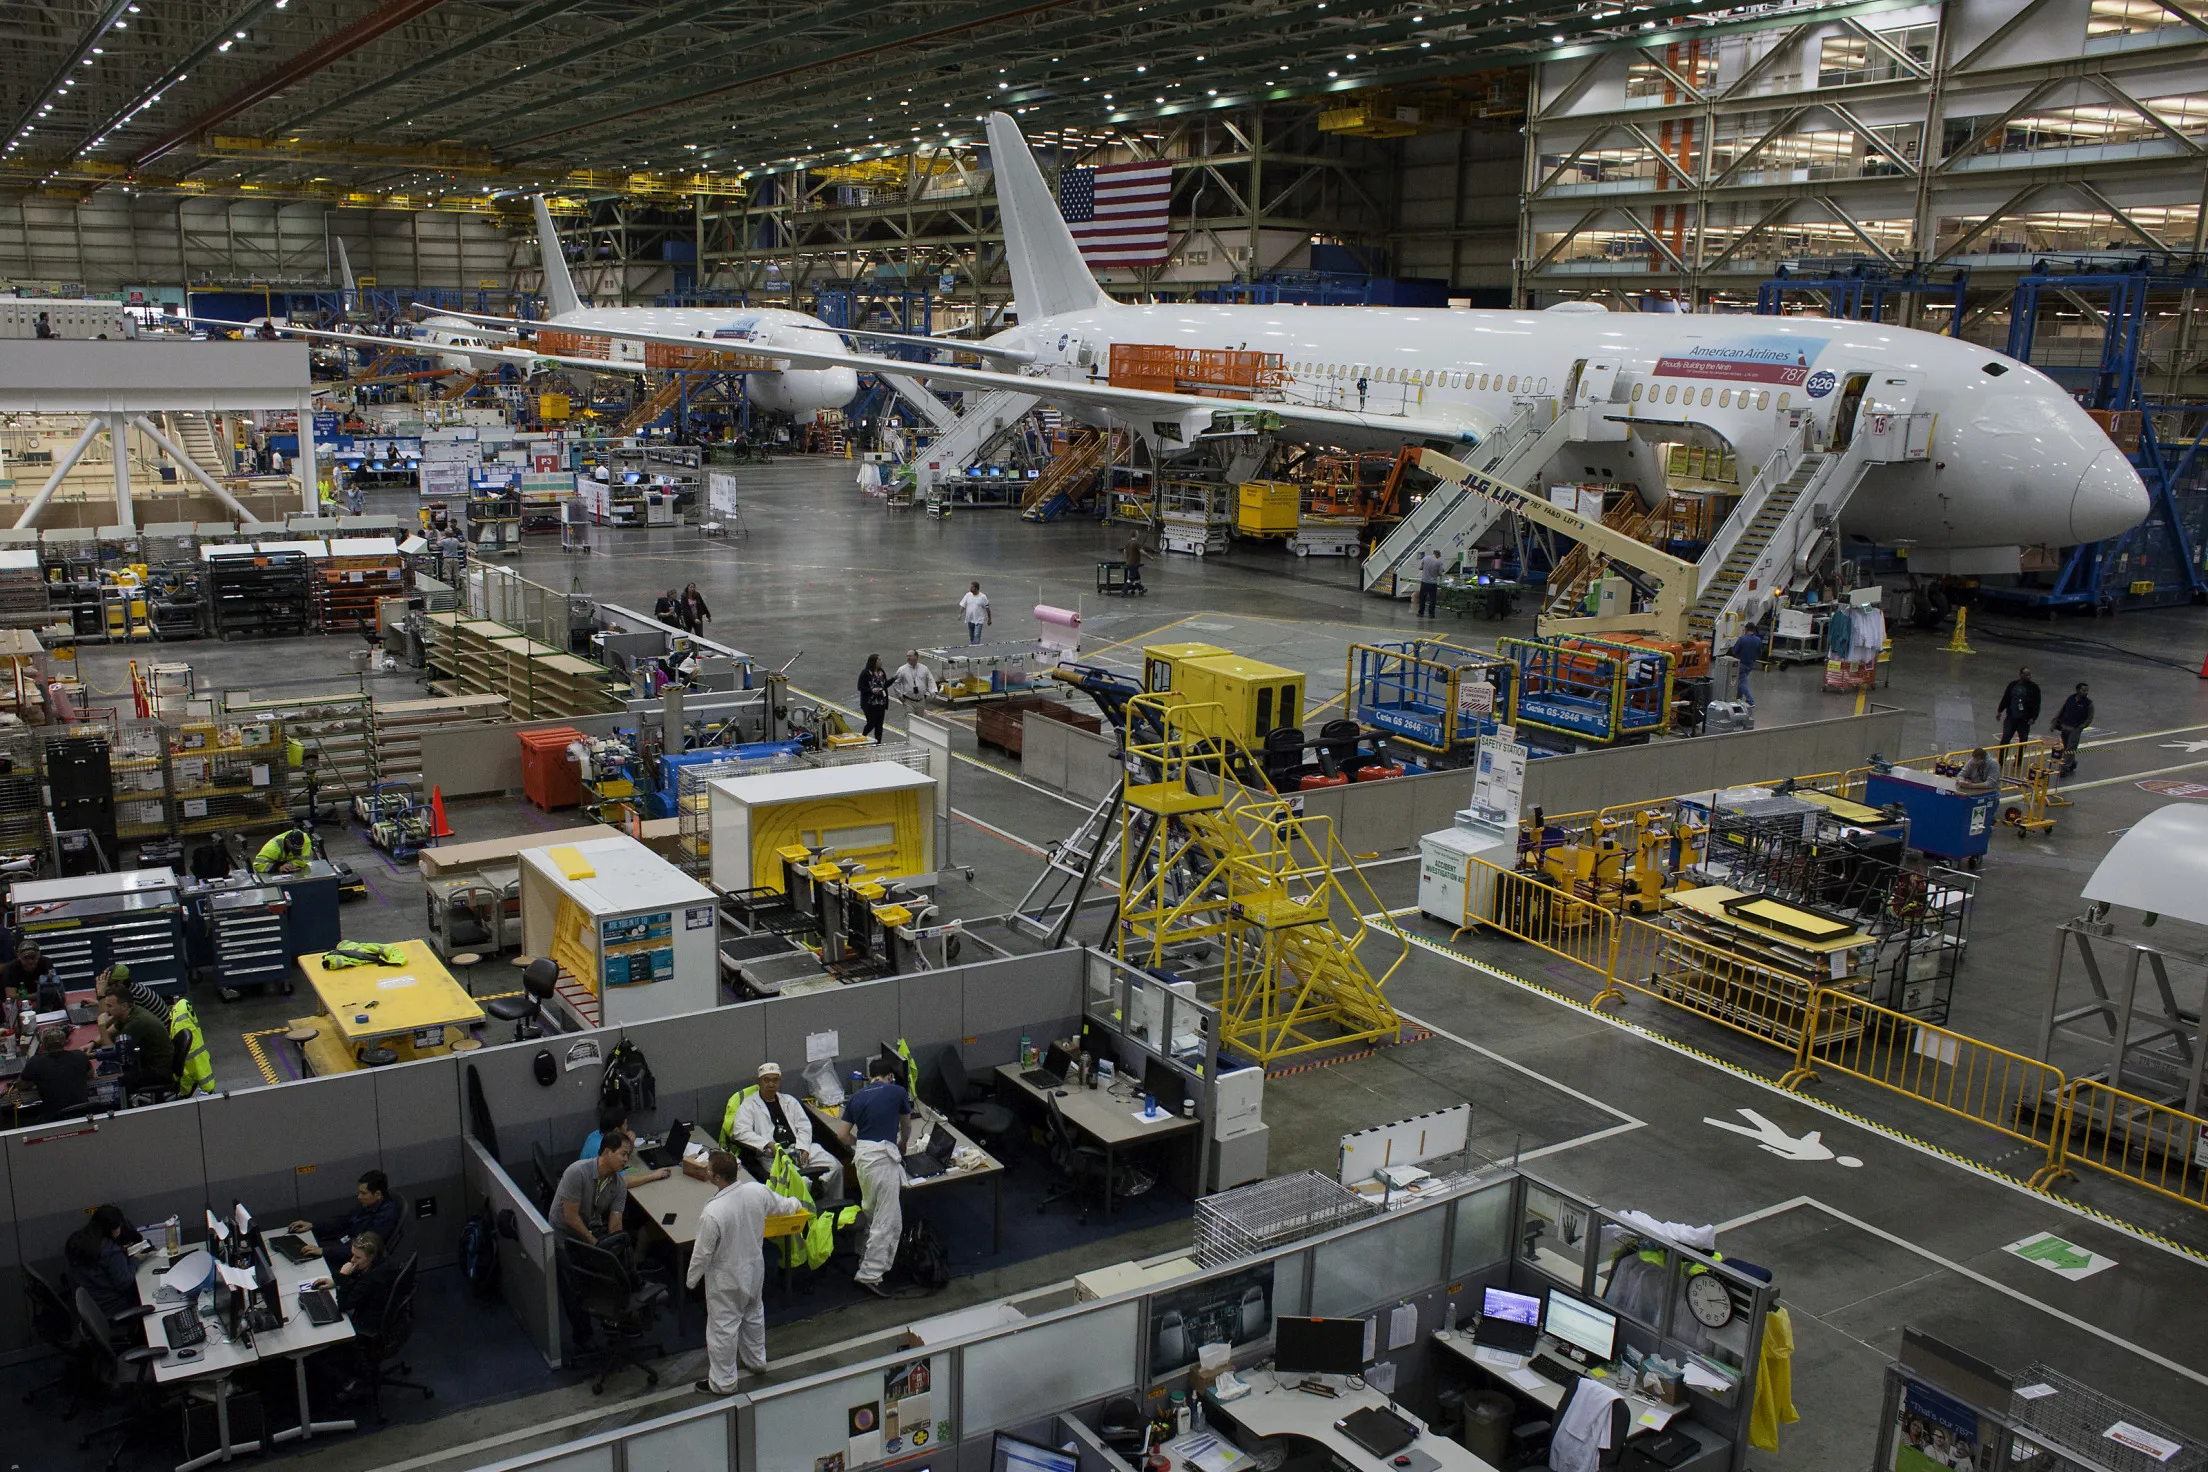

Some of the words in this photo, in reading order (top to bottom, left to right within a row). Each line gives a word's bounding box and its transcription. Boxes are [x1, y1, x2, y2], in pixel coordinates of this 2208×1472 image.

[1689, 346, 1744, 359] American
[1743, 348, 1791, 361] Airlines
[1661, 360, 1682, 371] Proudly
[1682, 362, 1705, 372] Building
[1779, 367, 1807, 381] 787
[1808, 377, 1834, 390] 326
[1875, 417, 1885, 433] 15
[2112, 415, 2119, 430] 1
[1460, 473, 1492, 495] JLG
[1491, 486, 1529, 510] LIFT
[1530, 500, 1542, 510] 787
[1543, 506, 1561, 519] FA&D
[1563, 515, 1579, 527] LIFT
[1678, 654, 1700, 669] JLG
[1525, 702, 1545, 716] Genie
[1546, 707, 1580, 723] GS-2646
[1393, 715, 1403, 726] GS
[1403, 717, 1421, 732] 2646
[1481, 737, 1503, 751] SAFETY
[1503, 743, 1527, 758] STATION
[1435, 859, 1456, 873] ACCIDENT
[1426, 864, 1458, 882] INVESTIGATION
[1458, 876, 1466, 884] KIT
[1939, 1417, 1953, 1429] our
